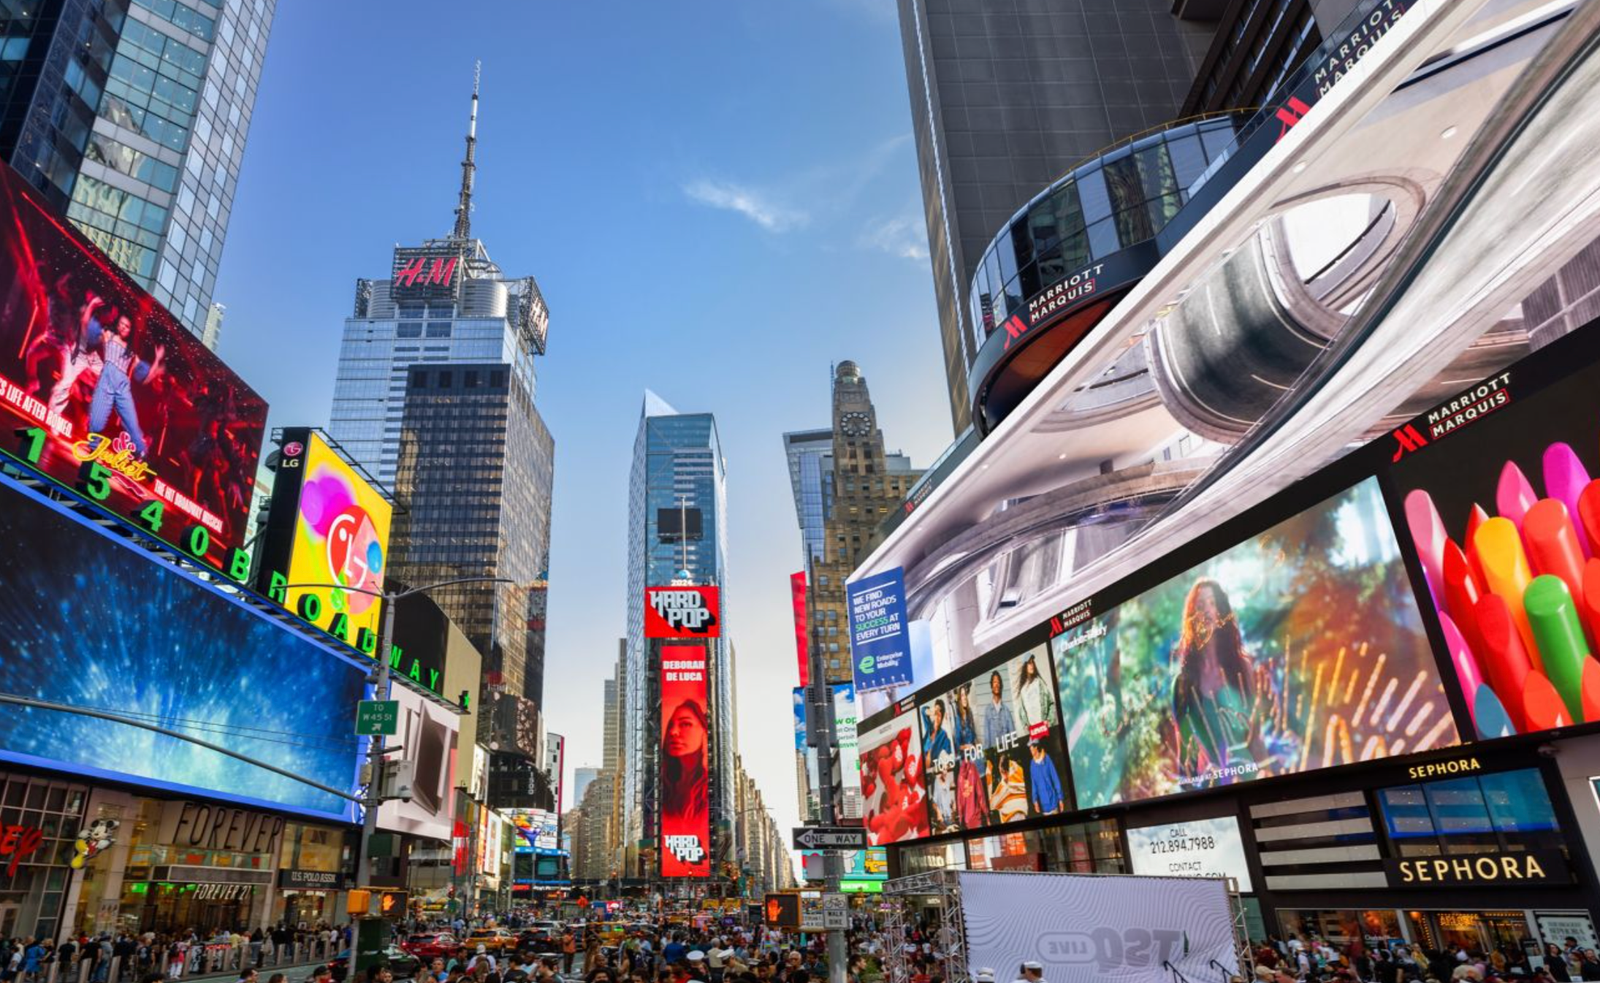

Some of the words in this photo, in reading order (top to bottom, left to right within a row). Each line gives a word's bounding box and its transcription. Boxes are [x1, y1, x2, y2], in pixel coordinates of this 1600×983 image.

[395, 256, 458, 287] H&M
[1029, 264, 1104, 312] MARRIOTT
[1031, 282, 1092, 322] MARQUIS
[6, 384, 24, 406] LIFE
[22, 395, 47, 421] AFTER
[1428, 372, 1510, 424] MARRIOTT
[1432, 392, 1506, 437] MARQUIS
[71, 432, 157, 481] Juliet
[282, 459, 299, 468] LG
[648, 591, 701, 618] HARD
[853, 595, 865, 605] WE
[865, 590, 883, 602] FIND
[854, 603, 871, 614] NEW
[871, 595, 897, 610] ROADS
[666, 608, 710, 628] POP
[855, 613, 866, 623] TO
[866, 607, 886, 619] YOUR
[1062, 599, 1092, 619] MARRIOTT
[1063, 609, 1091, 628] MARQUIS
[855, 616, 889, 632] SUCCESS
[889, 612, 899, 622] AT
[856, 628, 879, 641] EVERY
[880, 622, 900, 635] TURN
[663, 660, 705, 669] DEBORAH
[666, 672, 678, 681] DE
[679, 672, 703, 681] LUCA
[964, 744, 984, 761] FOR
[996, 731, 1019, 753] LIFE
[1212, 762, 1259, 780] SEPHORA
[1409, 757, 1480, 779] SEPHORA
[172, 802, 283, 854] FOREVER
[1170, 828, 1187, 838] CALL
[664, 835, 698, 854] HARD
[805, 834, 826, 843] ONE
[835, 834, 857, 843] WAY
[1150, 836, 1215, 854] 212.894.7988
[676, 847, 704, 862] POP
[1169, 861, 1202, 872] CONTACT
[1400, 855, 1546, 882] SEPHORA
[304, 872, 320, 882] POLO
[192, 884, 239, 900] FOREVER
[239, 885, 251, 900] 21
